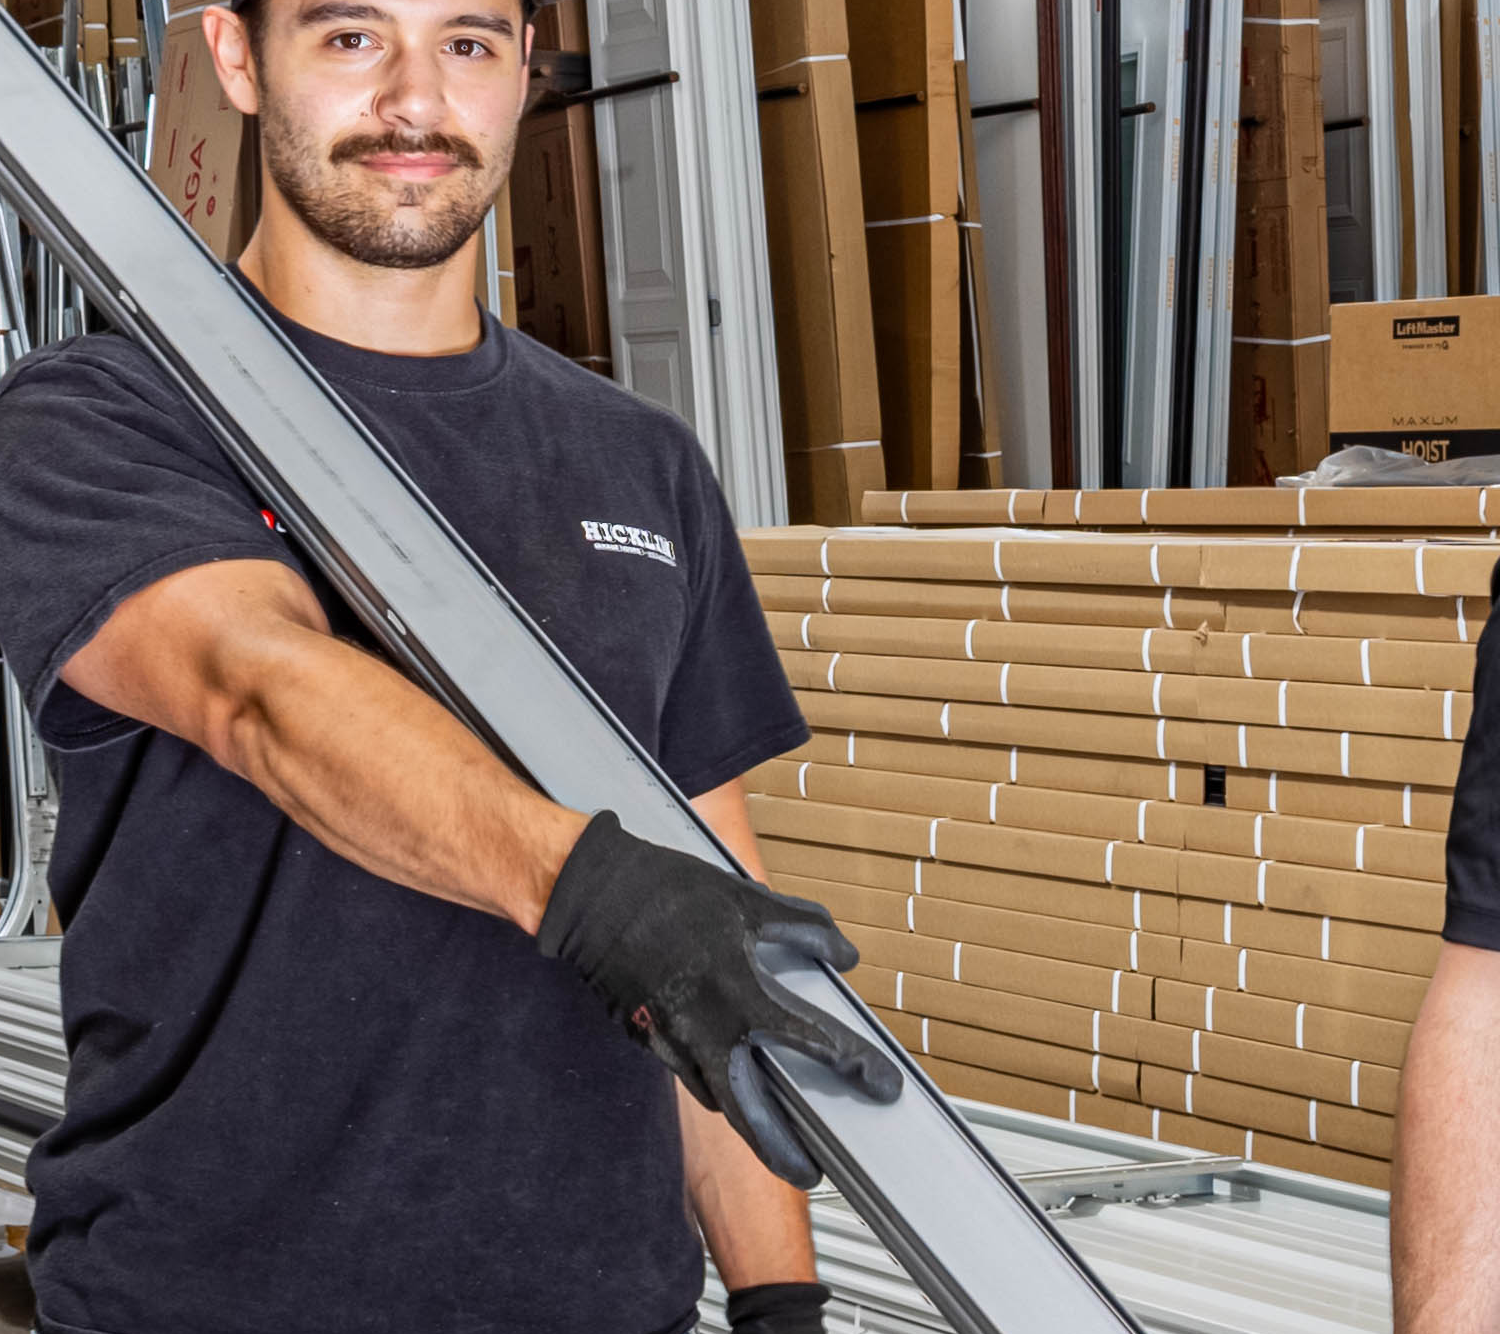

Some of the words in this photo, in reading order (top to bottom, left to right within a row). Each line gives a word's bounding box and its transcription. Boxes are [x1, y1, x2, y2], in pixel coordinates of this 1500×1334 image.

[1396, 321, 1456, 336] LiftMaster
[1392, 417, 1459, 426] MAXUM
[1402, 440, 1450, 463] HOIST
[581, 520, 675, 560] HICKLIN
